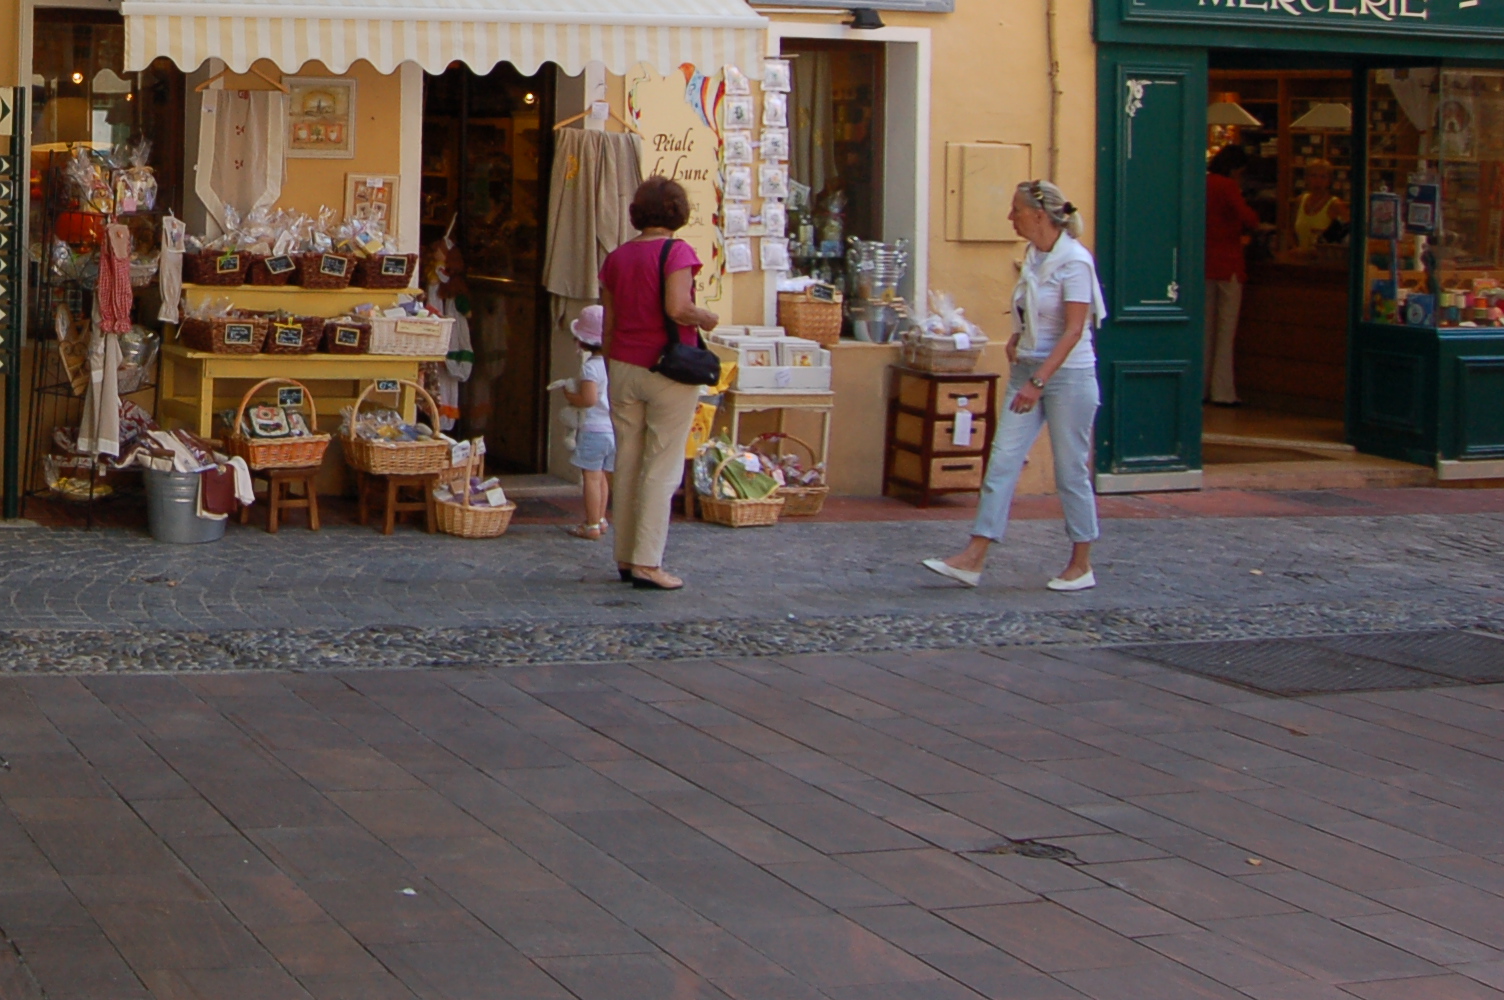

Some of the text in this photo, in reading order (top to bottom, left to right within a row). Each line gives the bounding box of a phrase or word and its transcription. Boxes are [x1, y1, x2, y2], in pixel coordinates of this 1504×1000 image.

[649, 127, 709, 181] Pétale de Lune
